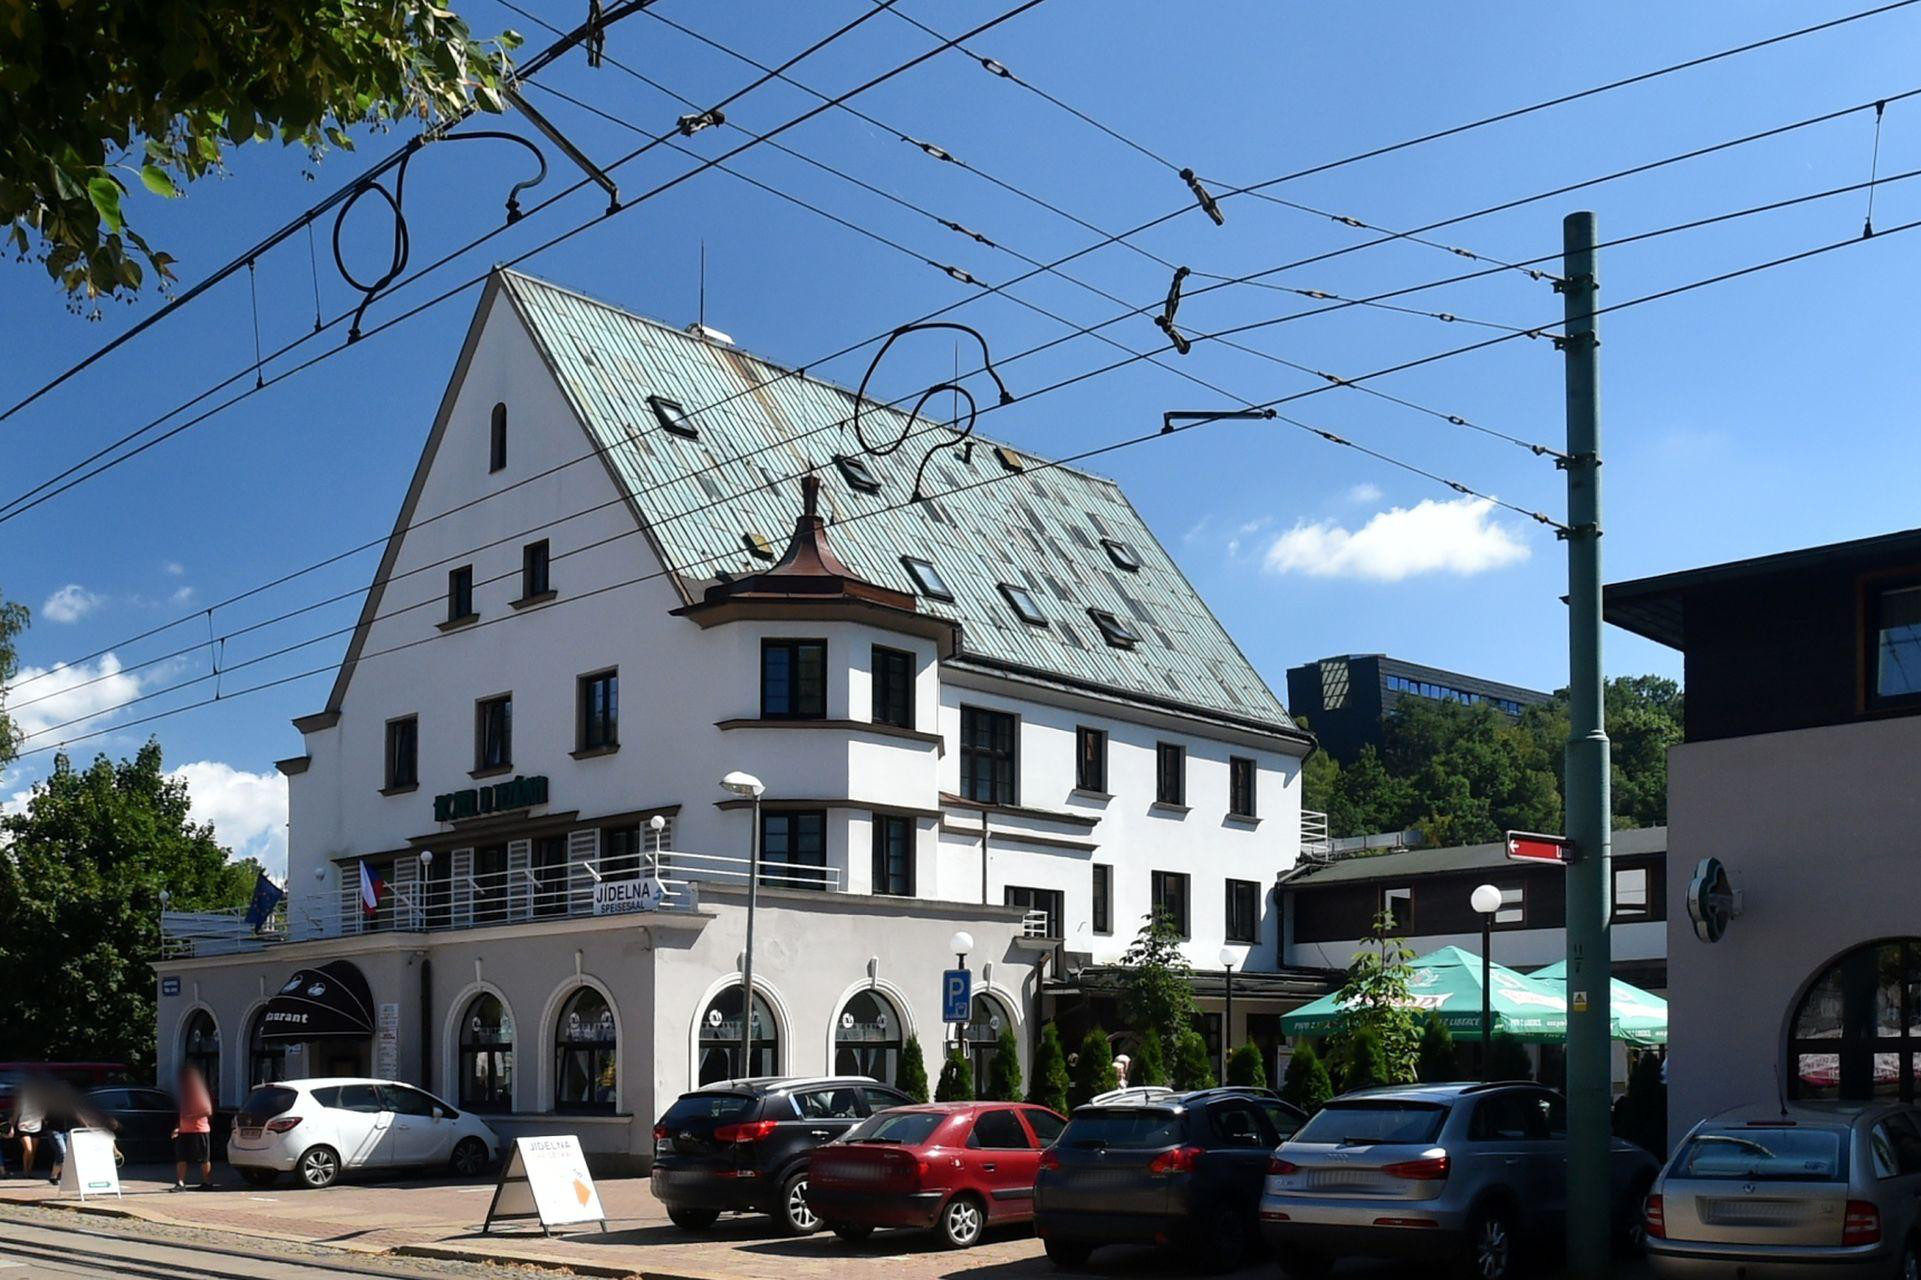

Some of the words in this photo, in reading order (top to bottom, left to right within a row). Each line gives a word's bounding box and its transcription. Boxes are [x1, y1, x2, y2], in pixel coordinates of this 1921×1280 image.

[596, 882, 650, 903] JÍDELNA
[601, 900, 645, 914] SPEISESAAL
[948, 977, 965, 1008] P
